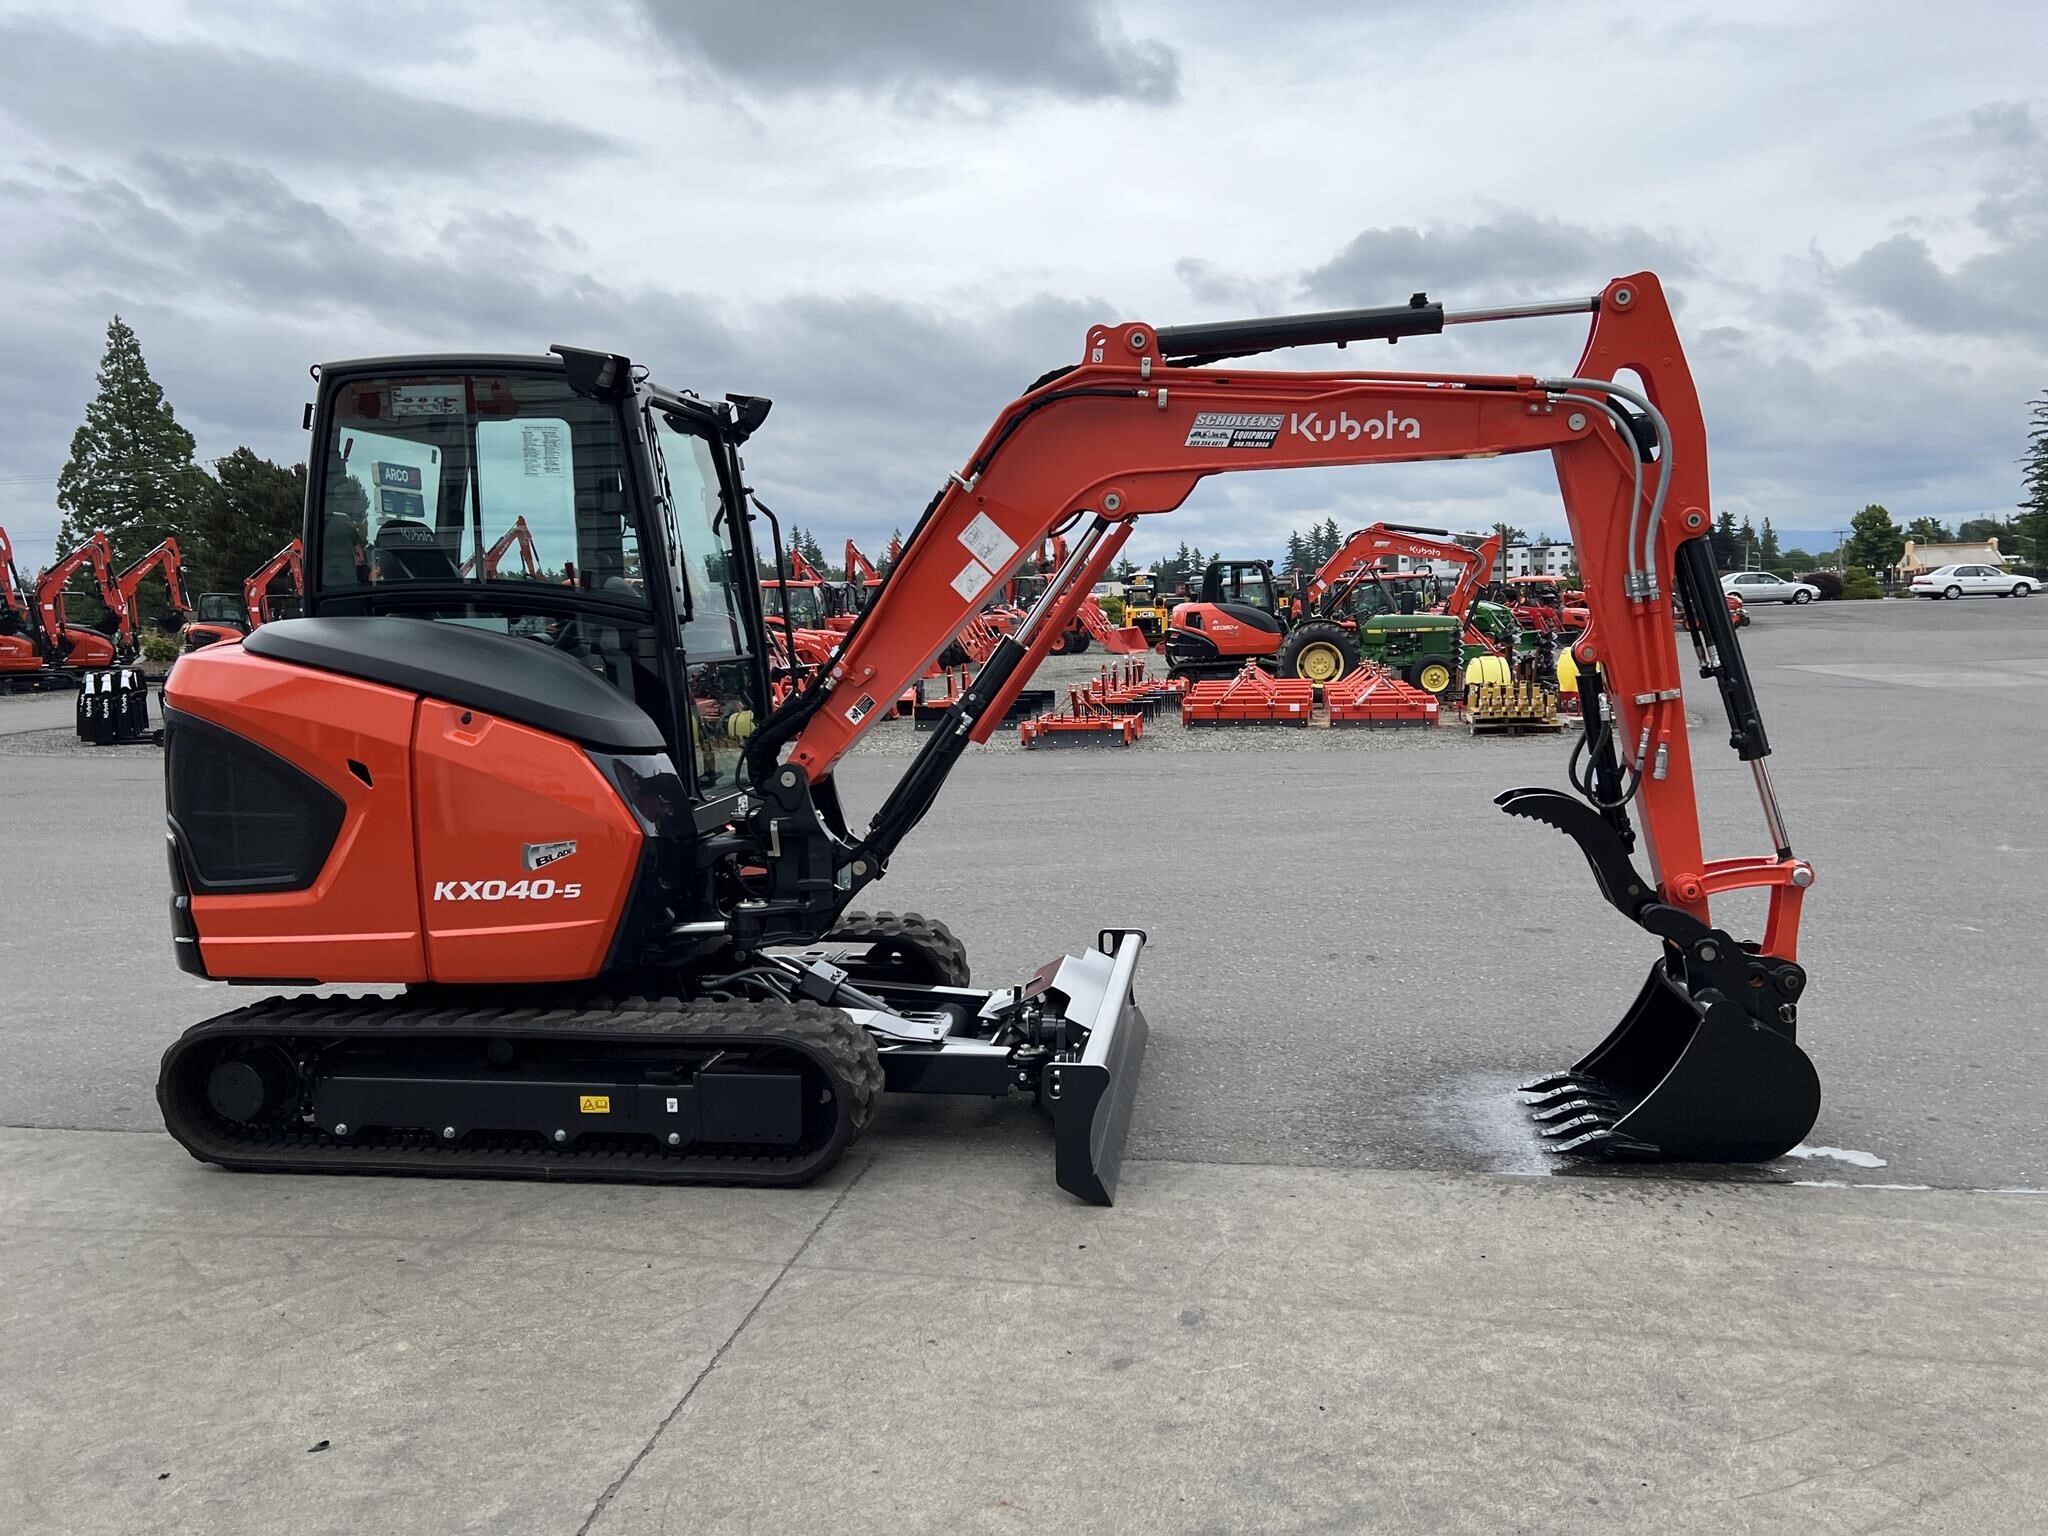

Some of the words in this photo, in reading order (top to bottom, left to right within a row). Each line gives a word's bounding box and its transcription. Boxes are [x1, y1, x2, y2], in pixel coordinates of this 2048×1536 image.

[1195, 414, 1281, 428] SCHOLTEN'S
[1290, 410, 1421, 442] Kubota
[1233, 431, 1277, 440] EQUIPMENT
[385, 467, 409, 483] ARCO
[1409, 545, 1441, 556] Kubota
[433, 879, 582, 901] KX040-5
